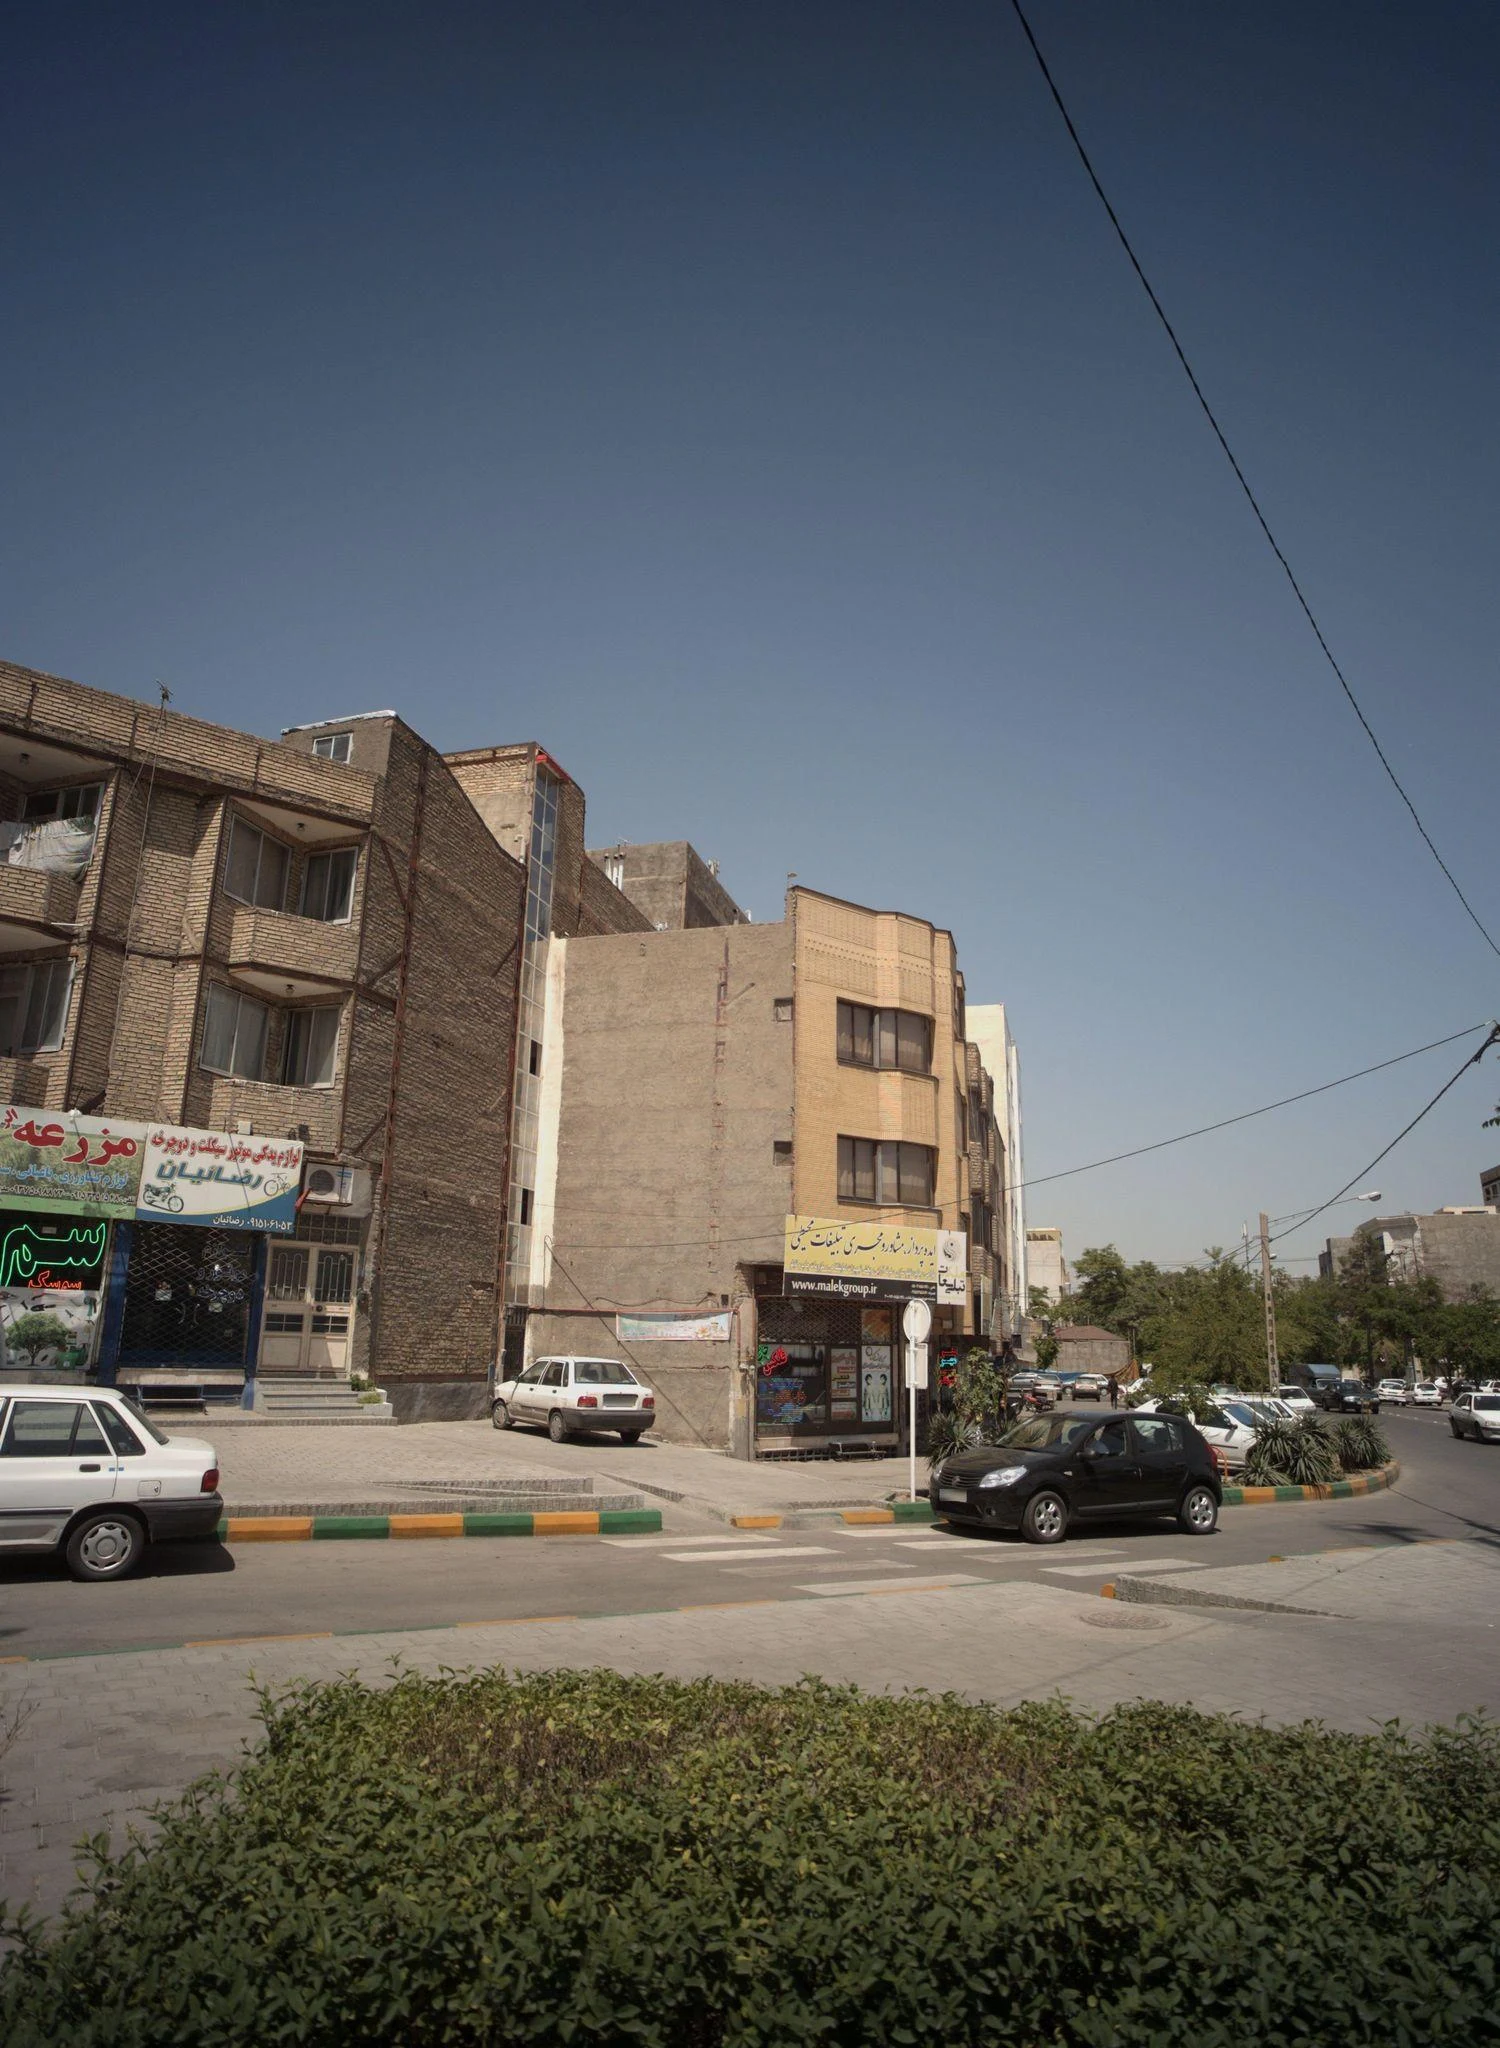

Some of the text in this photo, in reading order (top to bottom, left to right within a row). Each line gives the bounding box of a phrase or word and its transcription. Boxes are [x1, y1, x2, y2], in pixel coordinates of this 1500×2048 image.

[13, 1119, 138, 1166] مزرعه
[277, 1146, 301, 1169] لوازم
[791, 1279, 878, 1299] www.malekgroup.ir
